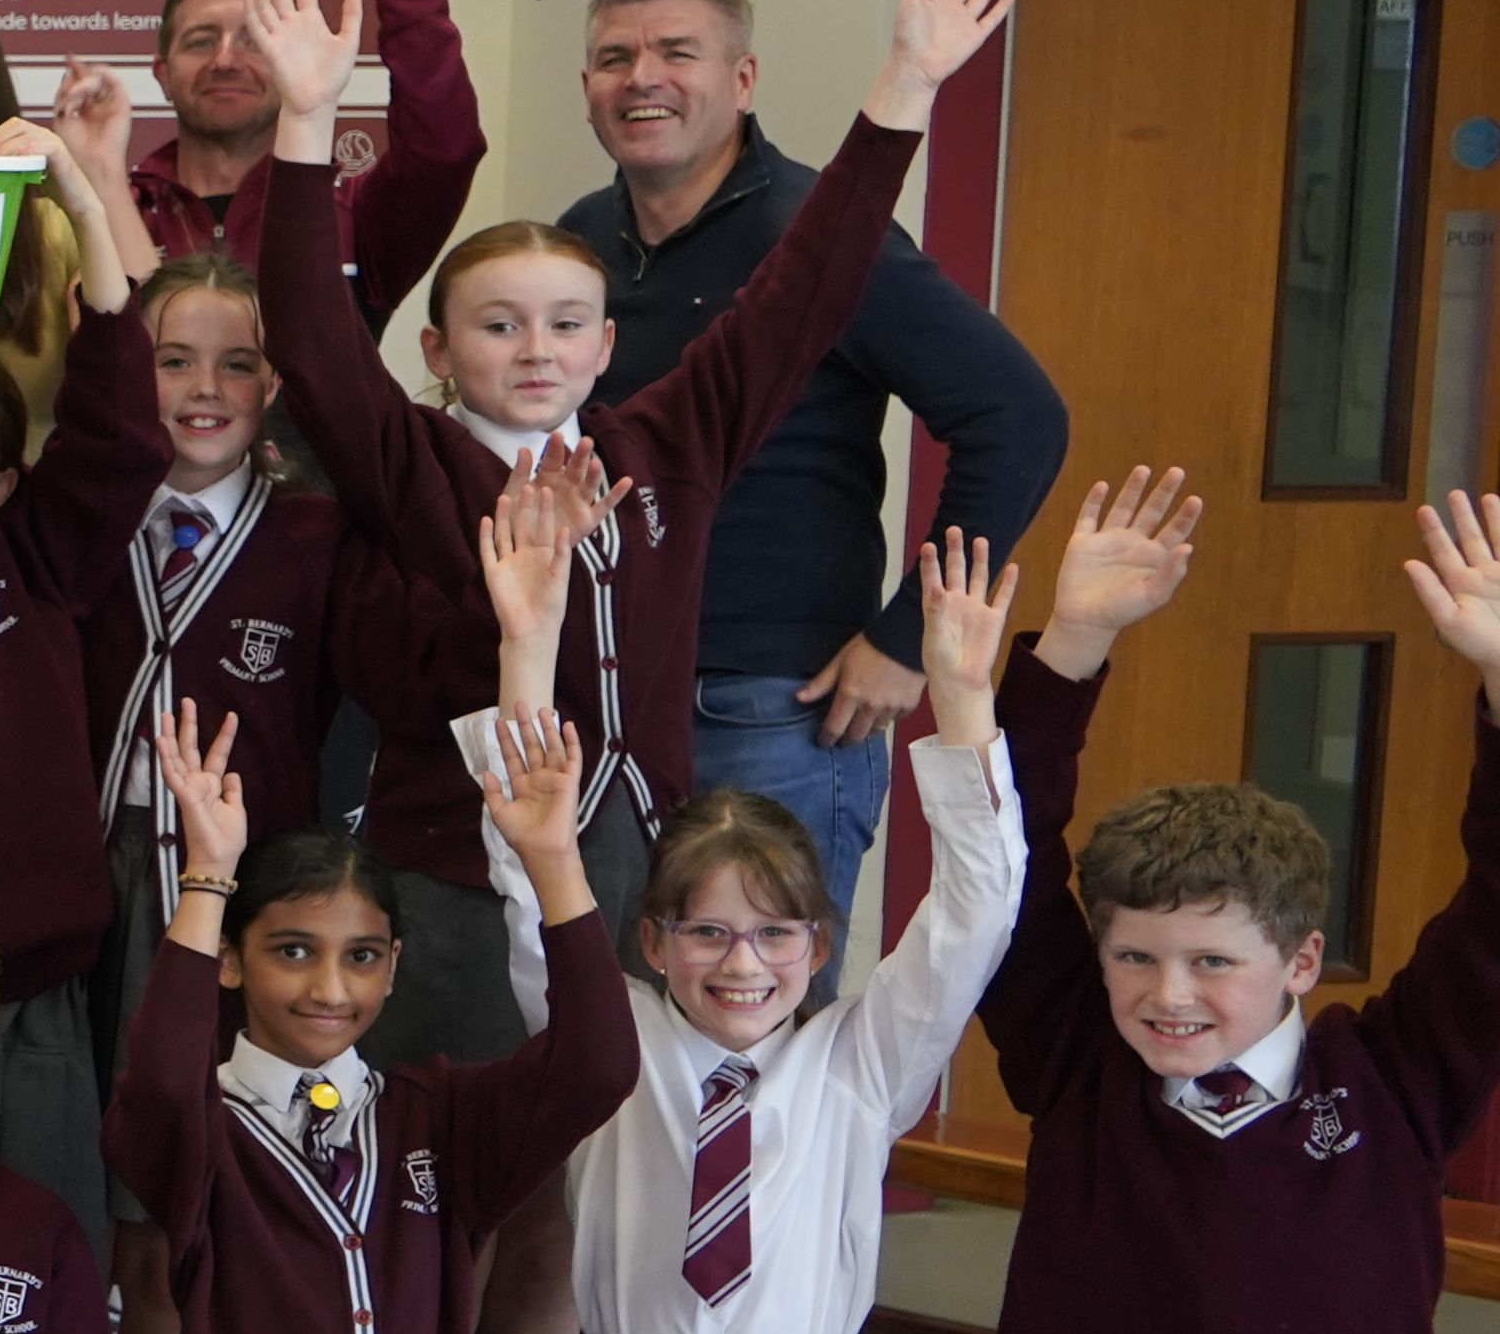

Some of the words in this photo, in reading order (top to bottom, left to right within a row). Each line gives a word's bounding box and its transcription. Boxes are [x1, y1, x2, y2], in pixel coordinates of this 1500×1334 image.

[31, 11, 111, 31] towards
[247, 618, 294, 640] BERNARD'S
[218, 656, 256, 683] PRIMARY
